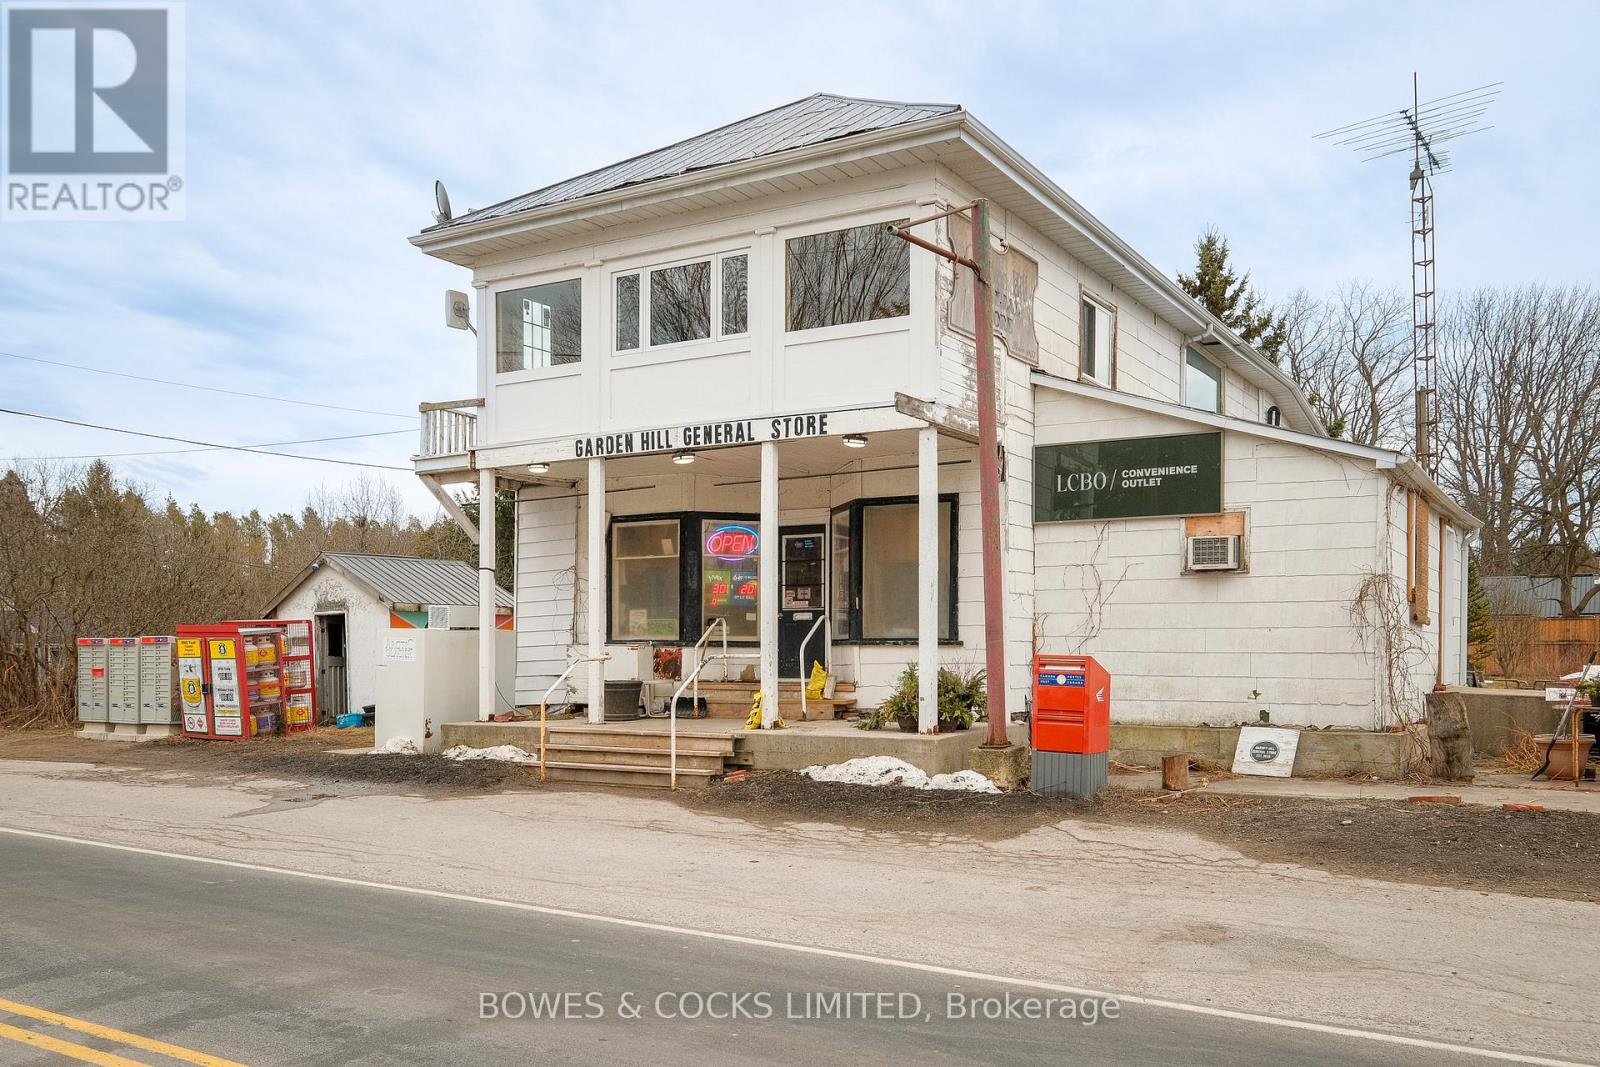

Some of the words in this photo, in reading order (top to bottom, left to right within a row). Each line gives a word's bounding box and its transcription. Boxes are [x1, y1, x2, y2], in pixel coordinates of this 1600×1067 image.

[575, 433, 634, 457] GARDEN
[640, 429, 673, 450] HILL
[683, 421, 755, 446] GENERAL
[771, 414, 828, 439] STORE
[1121, 465, 1198, 477] CONVENIENCE
[1056, 471, 1107, 493] LCBO
[1121, 478, 1162, 488] OUTLET
[710, 535, 755, 552] OPEN
